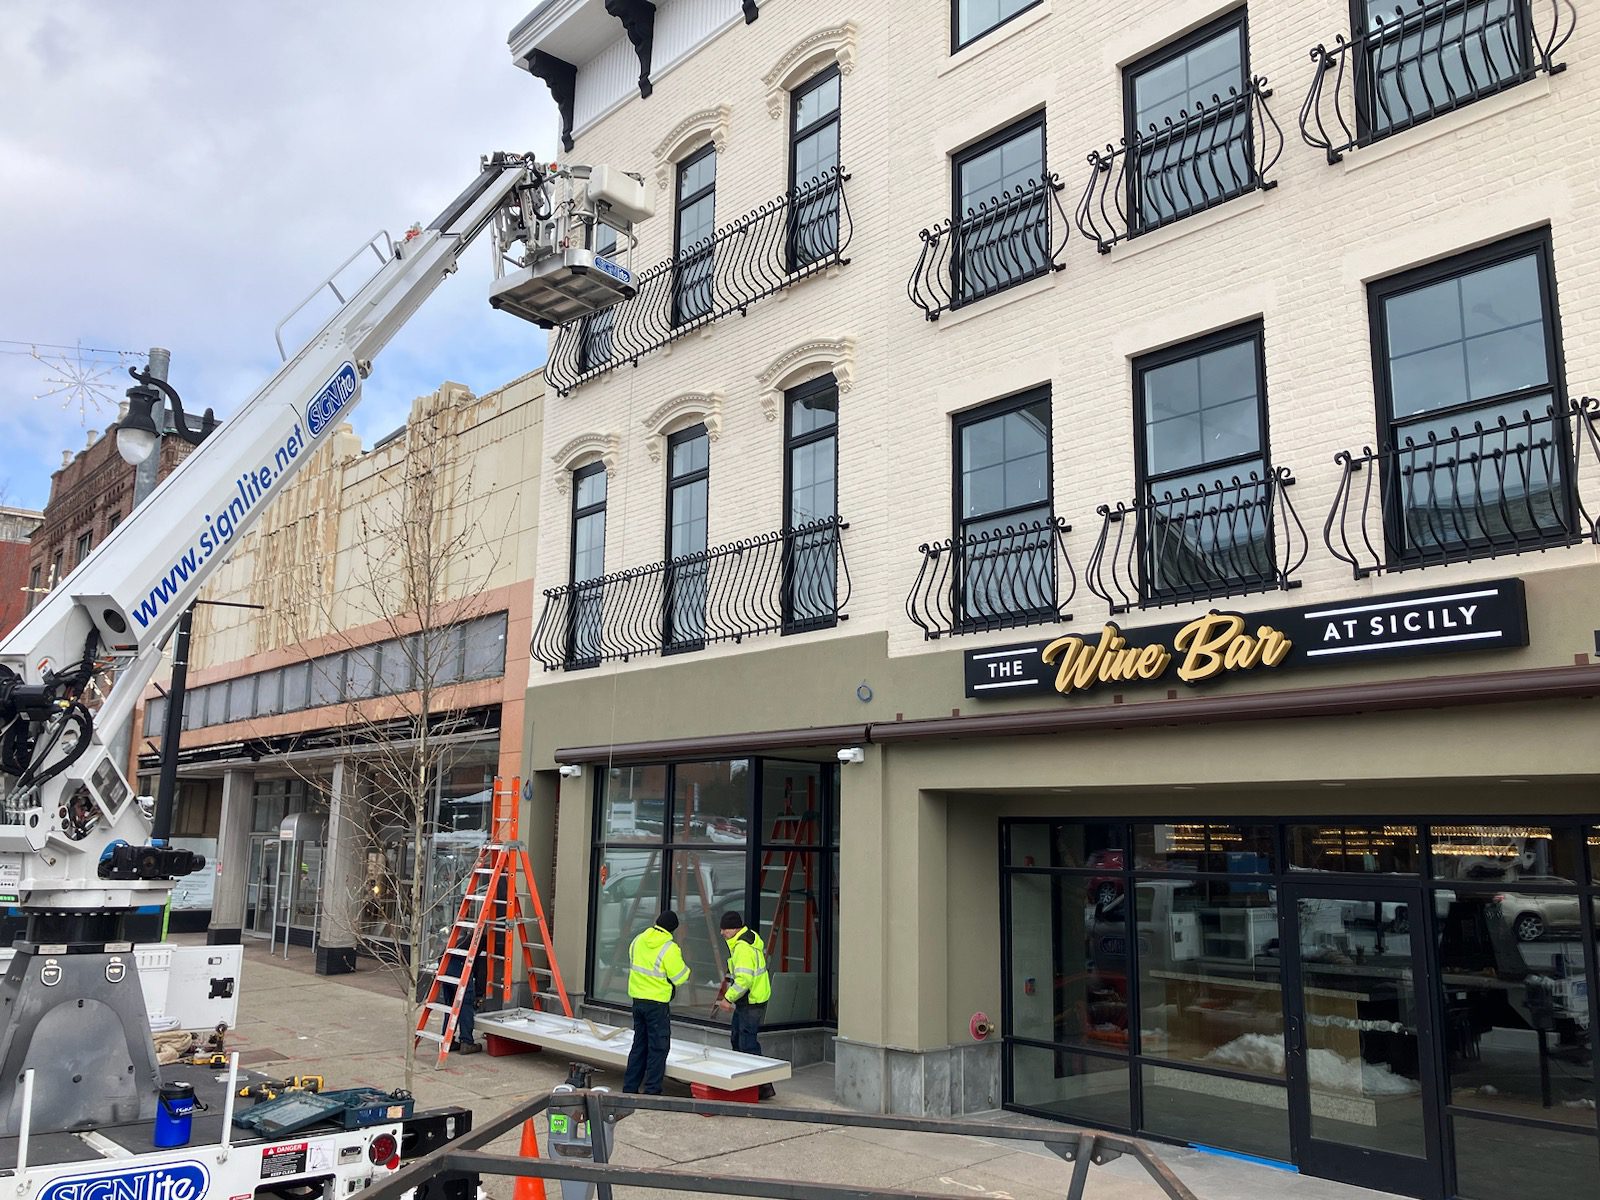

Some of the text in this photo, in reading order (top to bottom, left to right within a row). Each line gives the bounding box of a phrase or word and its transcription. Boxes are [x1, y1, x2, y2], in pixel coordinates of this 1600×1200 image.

[310, 374, 354, 433] SIGNlite
[132, 424, 305, 628] www.signlite.net
[1323, 605, 1478, 642] AT SICILY
[987, 659, 1024, 679] THE
[1042, 612, 1293, 693] Wine Bar
[276, 1144, 302, 1152] DANGER
